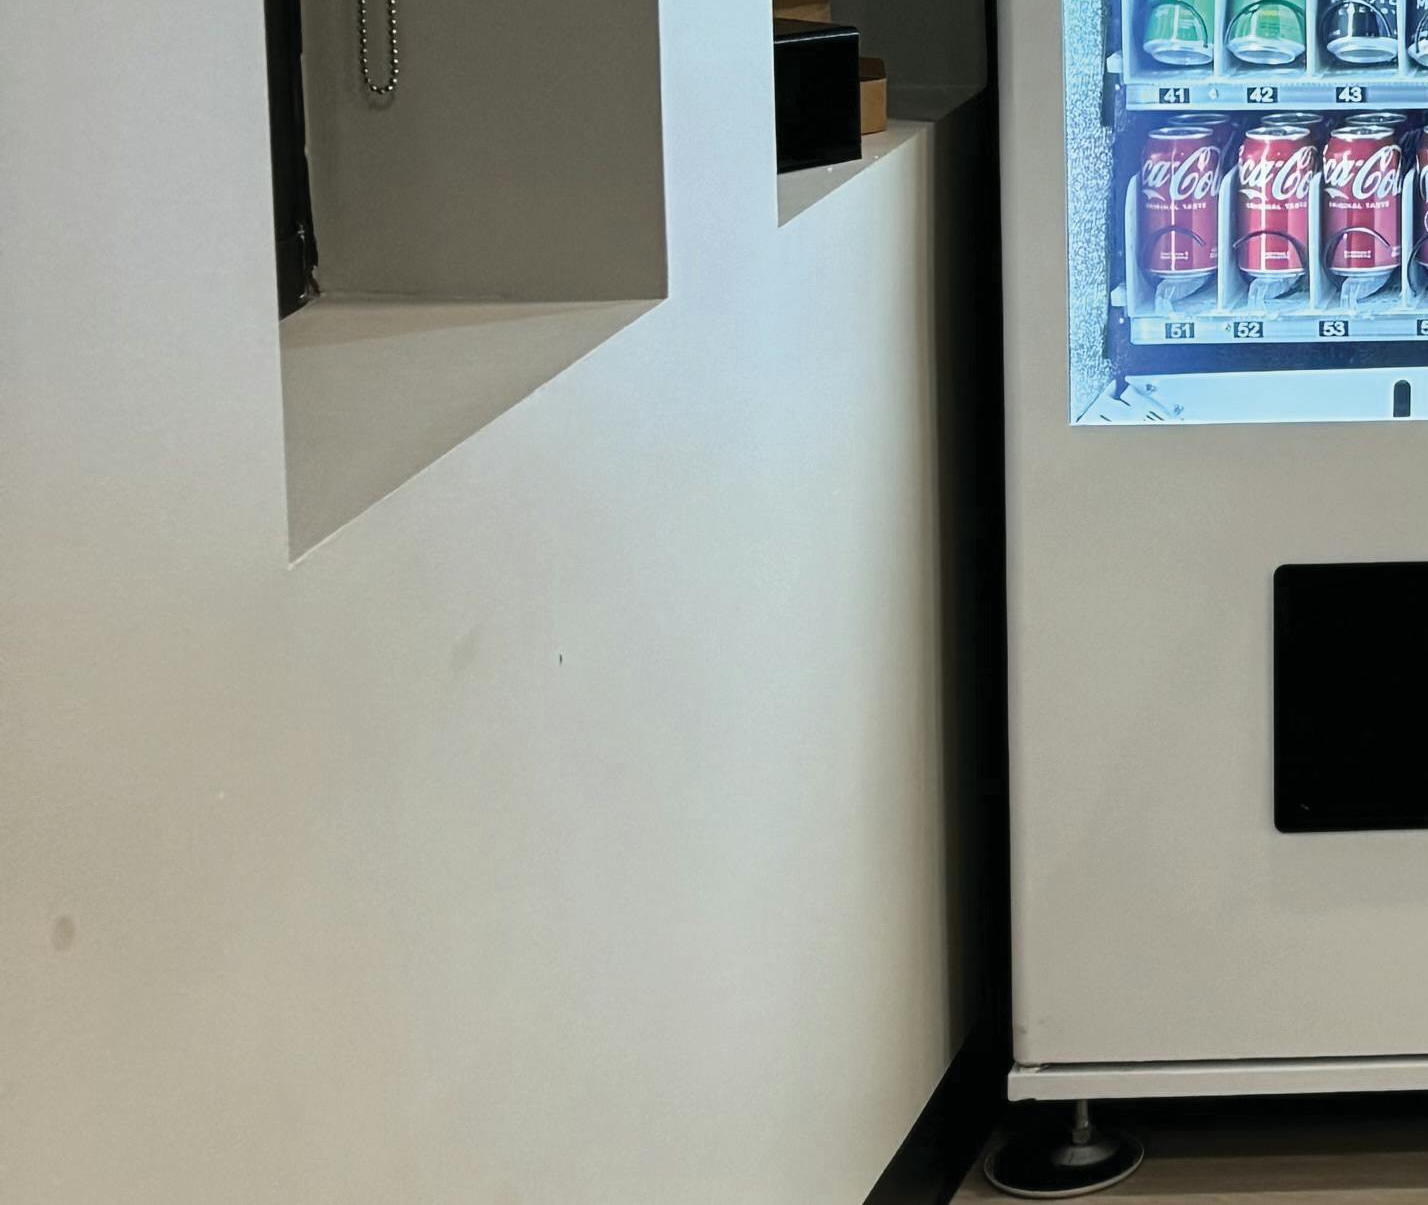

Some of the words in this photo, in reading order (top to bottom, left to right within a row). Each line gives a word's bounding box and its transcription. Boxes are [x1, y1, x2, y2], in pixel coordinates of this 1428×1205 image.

[1164, 87, 1187, 103] 41
[1250, 87, 1275, 103] 42
[1339, 87, 1363, 103] 43
[1170, 323, 1192, 338] 51
[1237, 322, 1261, 338] 52
[1322, 321, 1346, 337] 53
